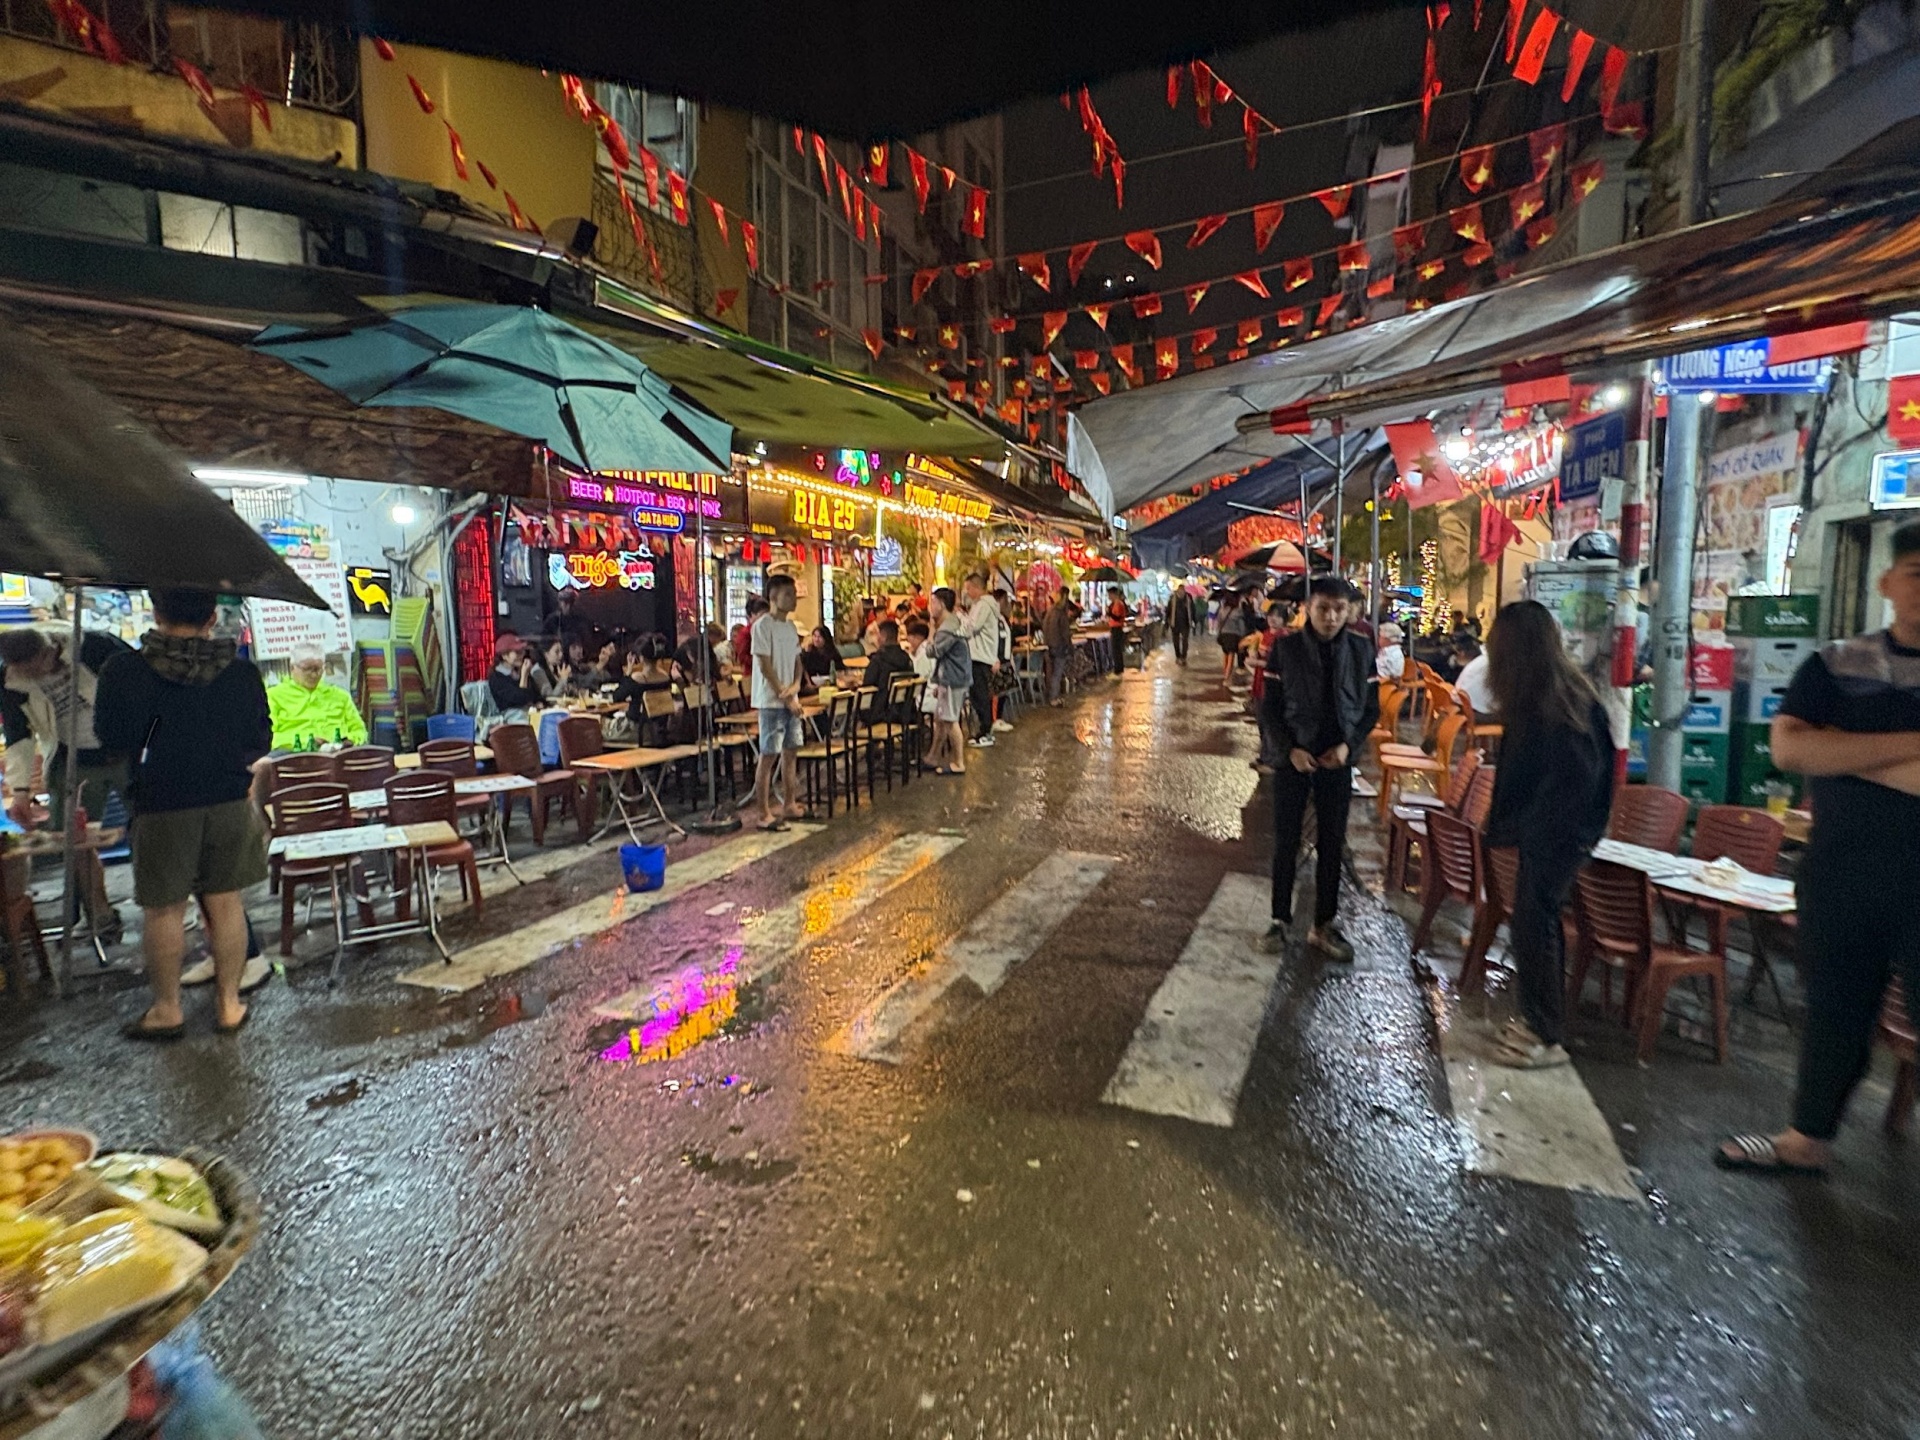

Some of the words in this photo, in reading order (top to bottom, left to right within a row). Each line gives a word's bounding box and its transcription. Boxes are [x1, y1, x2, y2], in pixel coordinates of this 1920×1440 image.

[570, 478, 603, 502] BEER
[614, 484, 657, 506] HOTPOT
[665, 492, 686, 513] BBQ
[794, 489, 832, 527] BIA
[833, 498, 855, 531] 29
[261, 605, 296, 613] WHISKY
[262, 615, 296, 623] MOJITO
[264, 626, 285, 634] RUM
[266, 635, 301, 644] WHISKY
